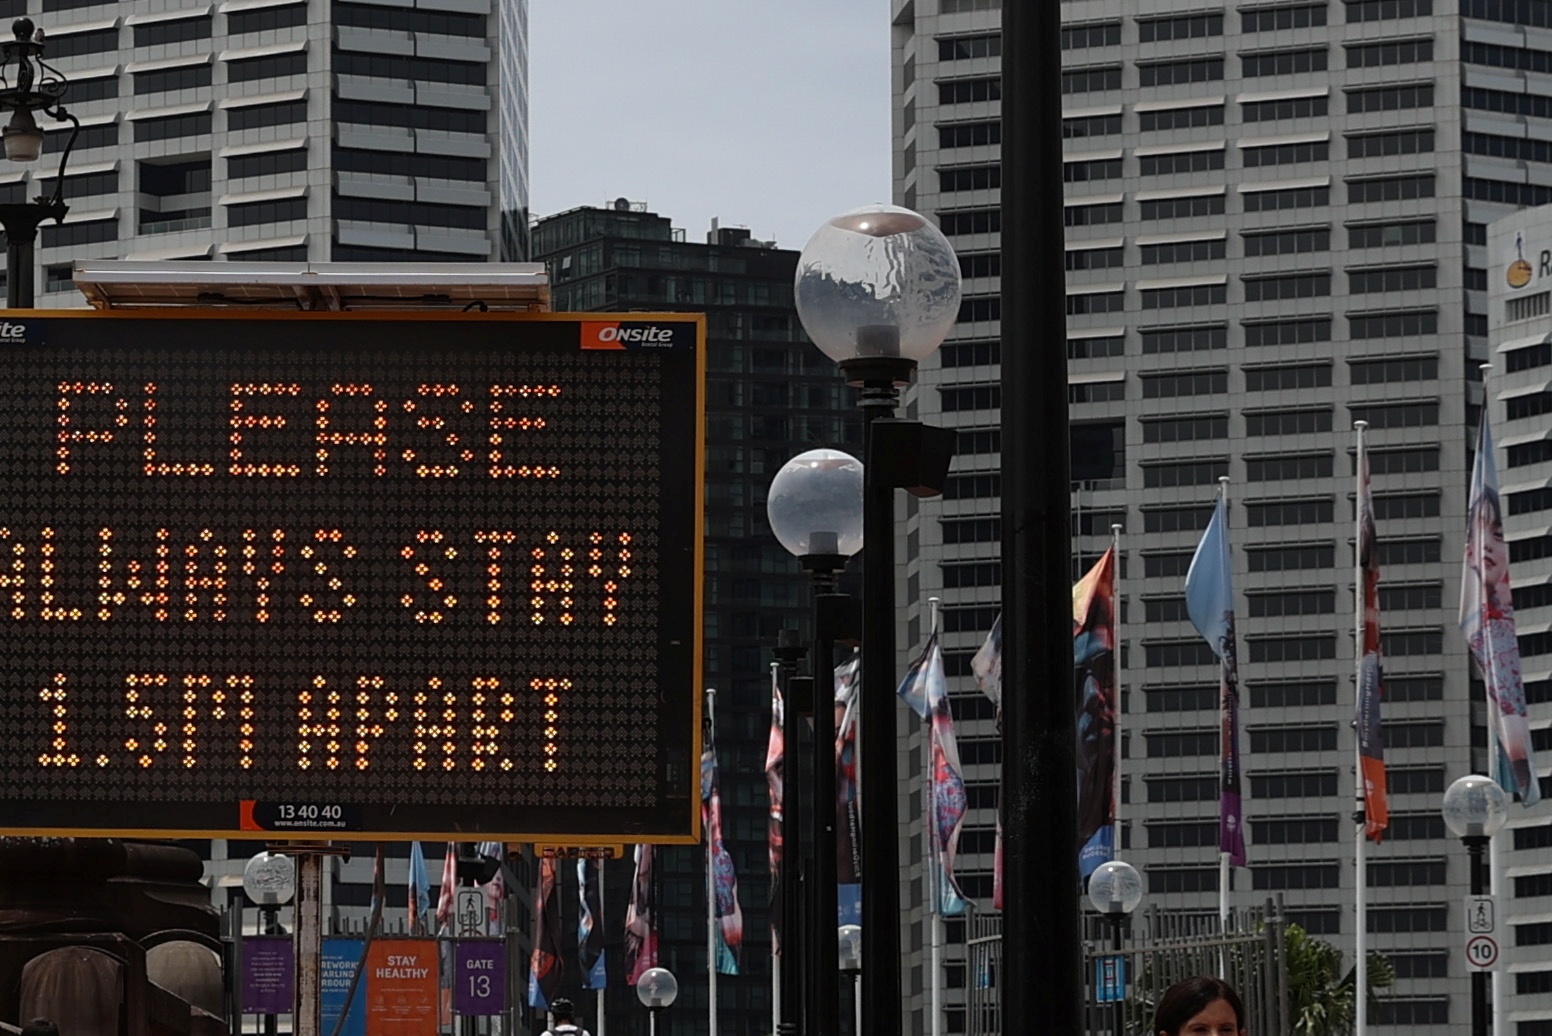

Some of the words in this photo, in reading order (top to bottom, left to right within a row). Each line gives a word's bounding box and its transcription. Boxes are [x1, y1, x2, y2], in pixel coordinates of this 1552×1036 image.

[57, 382, 562, 477] PLEASE
[401, 530, 632, 627] STAY
[38, 673, 255, 769] 1.5M
[297, 675, 573, 773] APART
[278, 804, 295, 819] 13
[297, 804, 319, 819] 40
[321, 805, 343, 819] 40
[274, 819, 346, 828] www.onsite.com.au
[1472, 944, 1492, 959] 10
[321, 961, 359, 970] REWORK
[387, 955, 417, 966] STAY
[466, 959, 494, 969] GATE
[321, 970, 355, 978] ARLING
[375, 968, 429, 979] HEALTHY
[469, 976, 491, 997] 13
